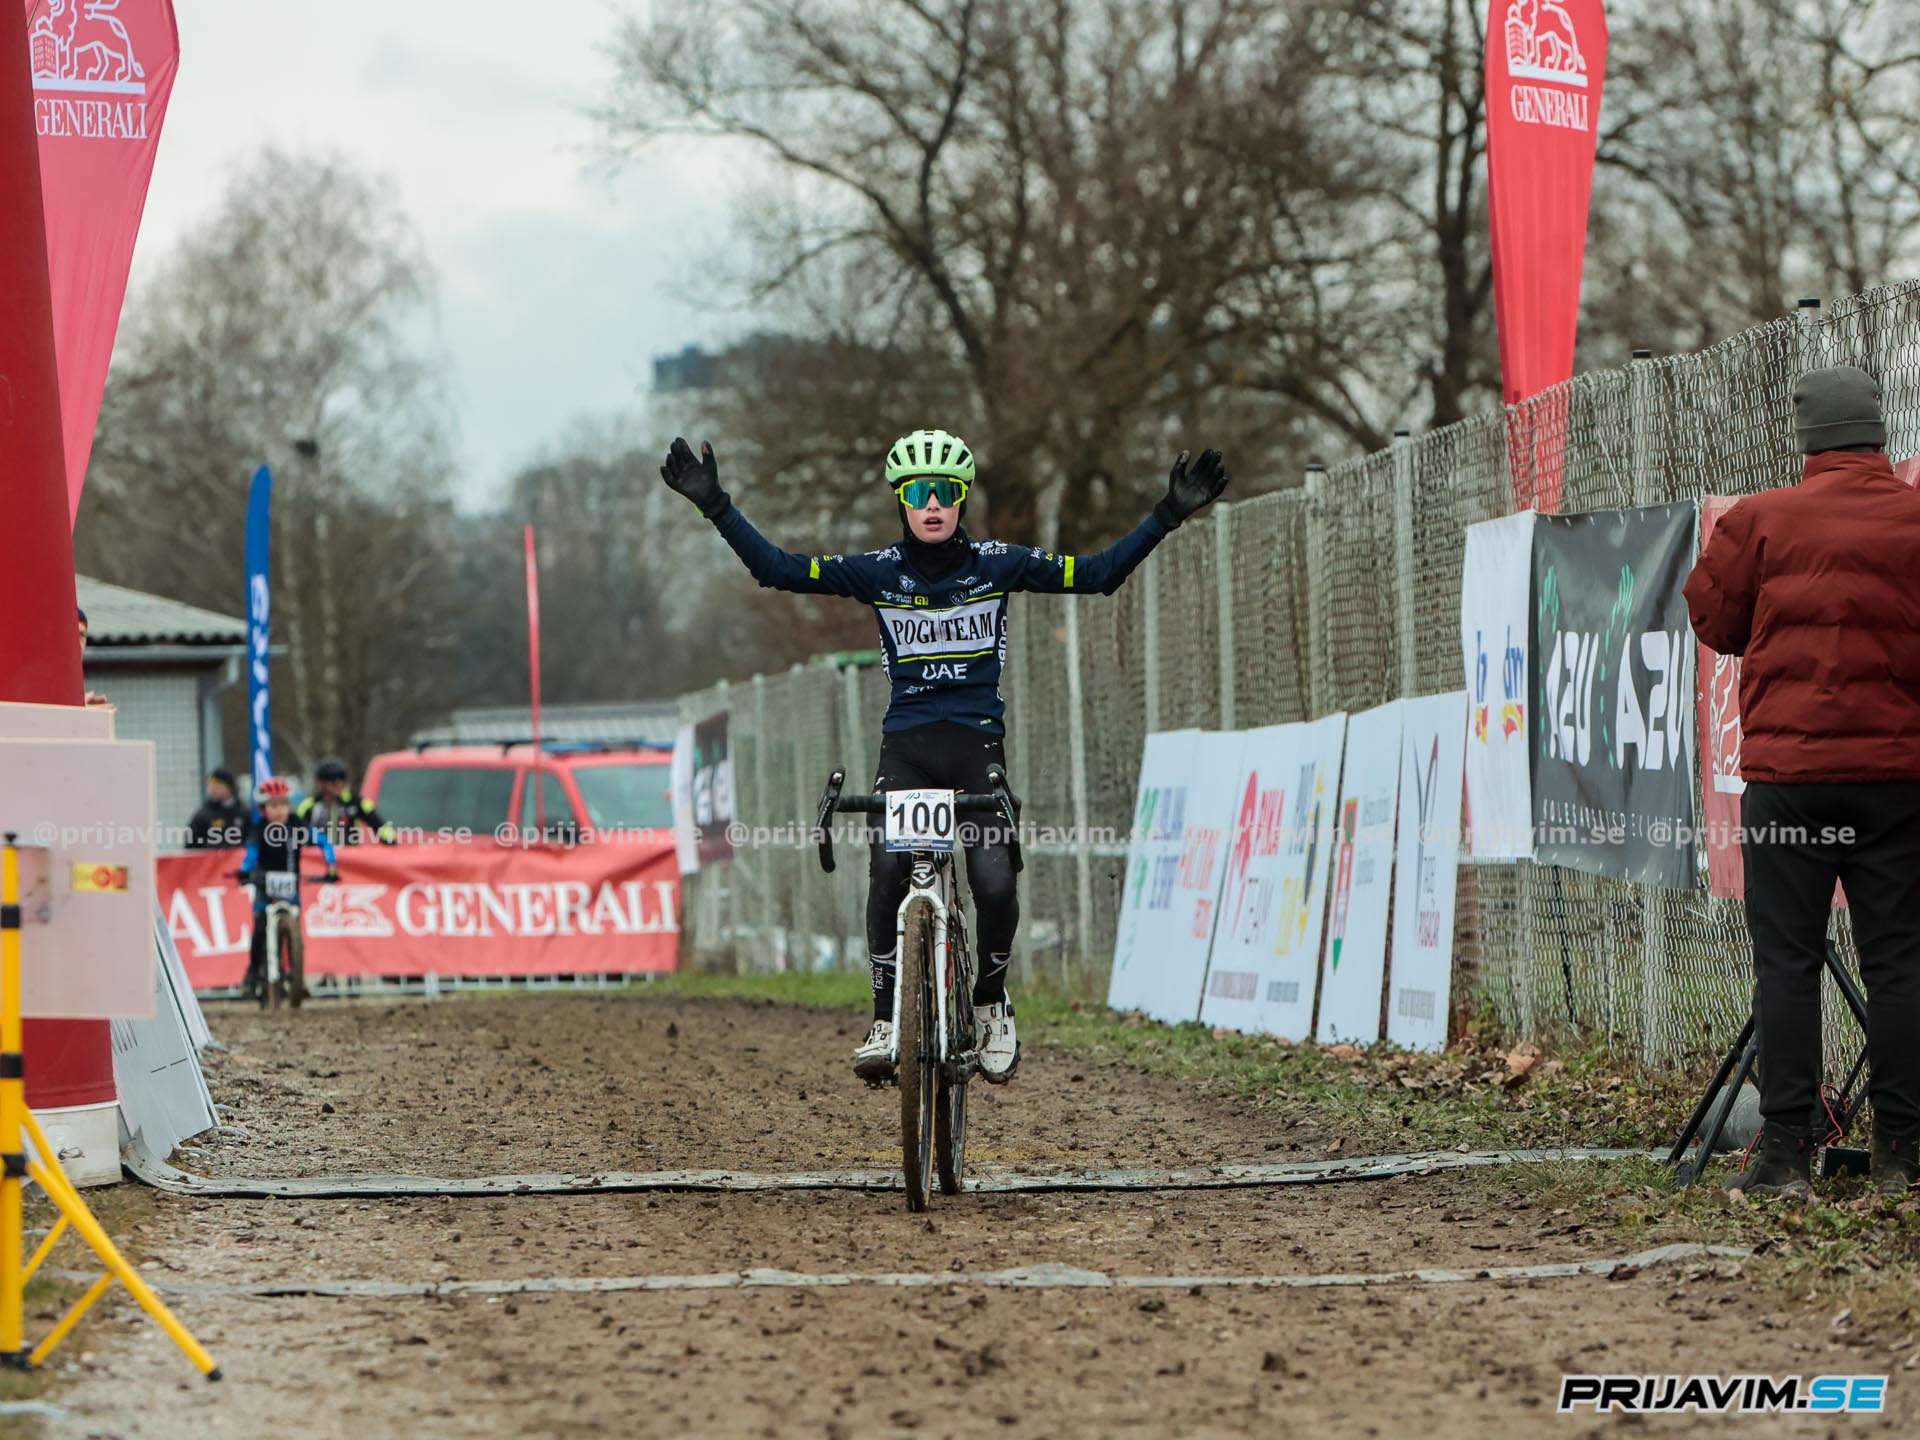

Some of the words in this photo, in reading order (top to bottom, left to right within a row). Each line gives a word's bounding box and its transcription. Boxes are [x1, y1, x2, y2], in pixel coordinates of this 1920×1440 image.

[34, 98, 148, 139] GENERALI
[1510, 84, 1589, 132] GENERALI
[892, 619, 938, 646] POGI
[941, 611, 995, 642] TEAM
[922, 663, 968, 680] UAE
[892, 802, 952, 837] 100
[396, 879, 679, 937] GENERALI
